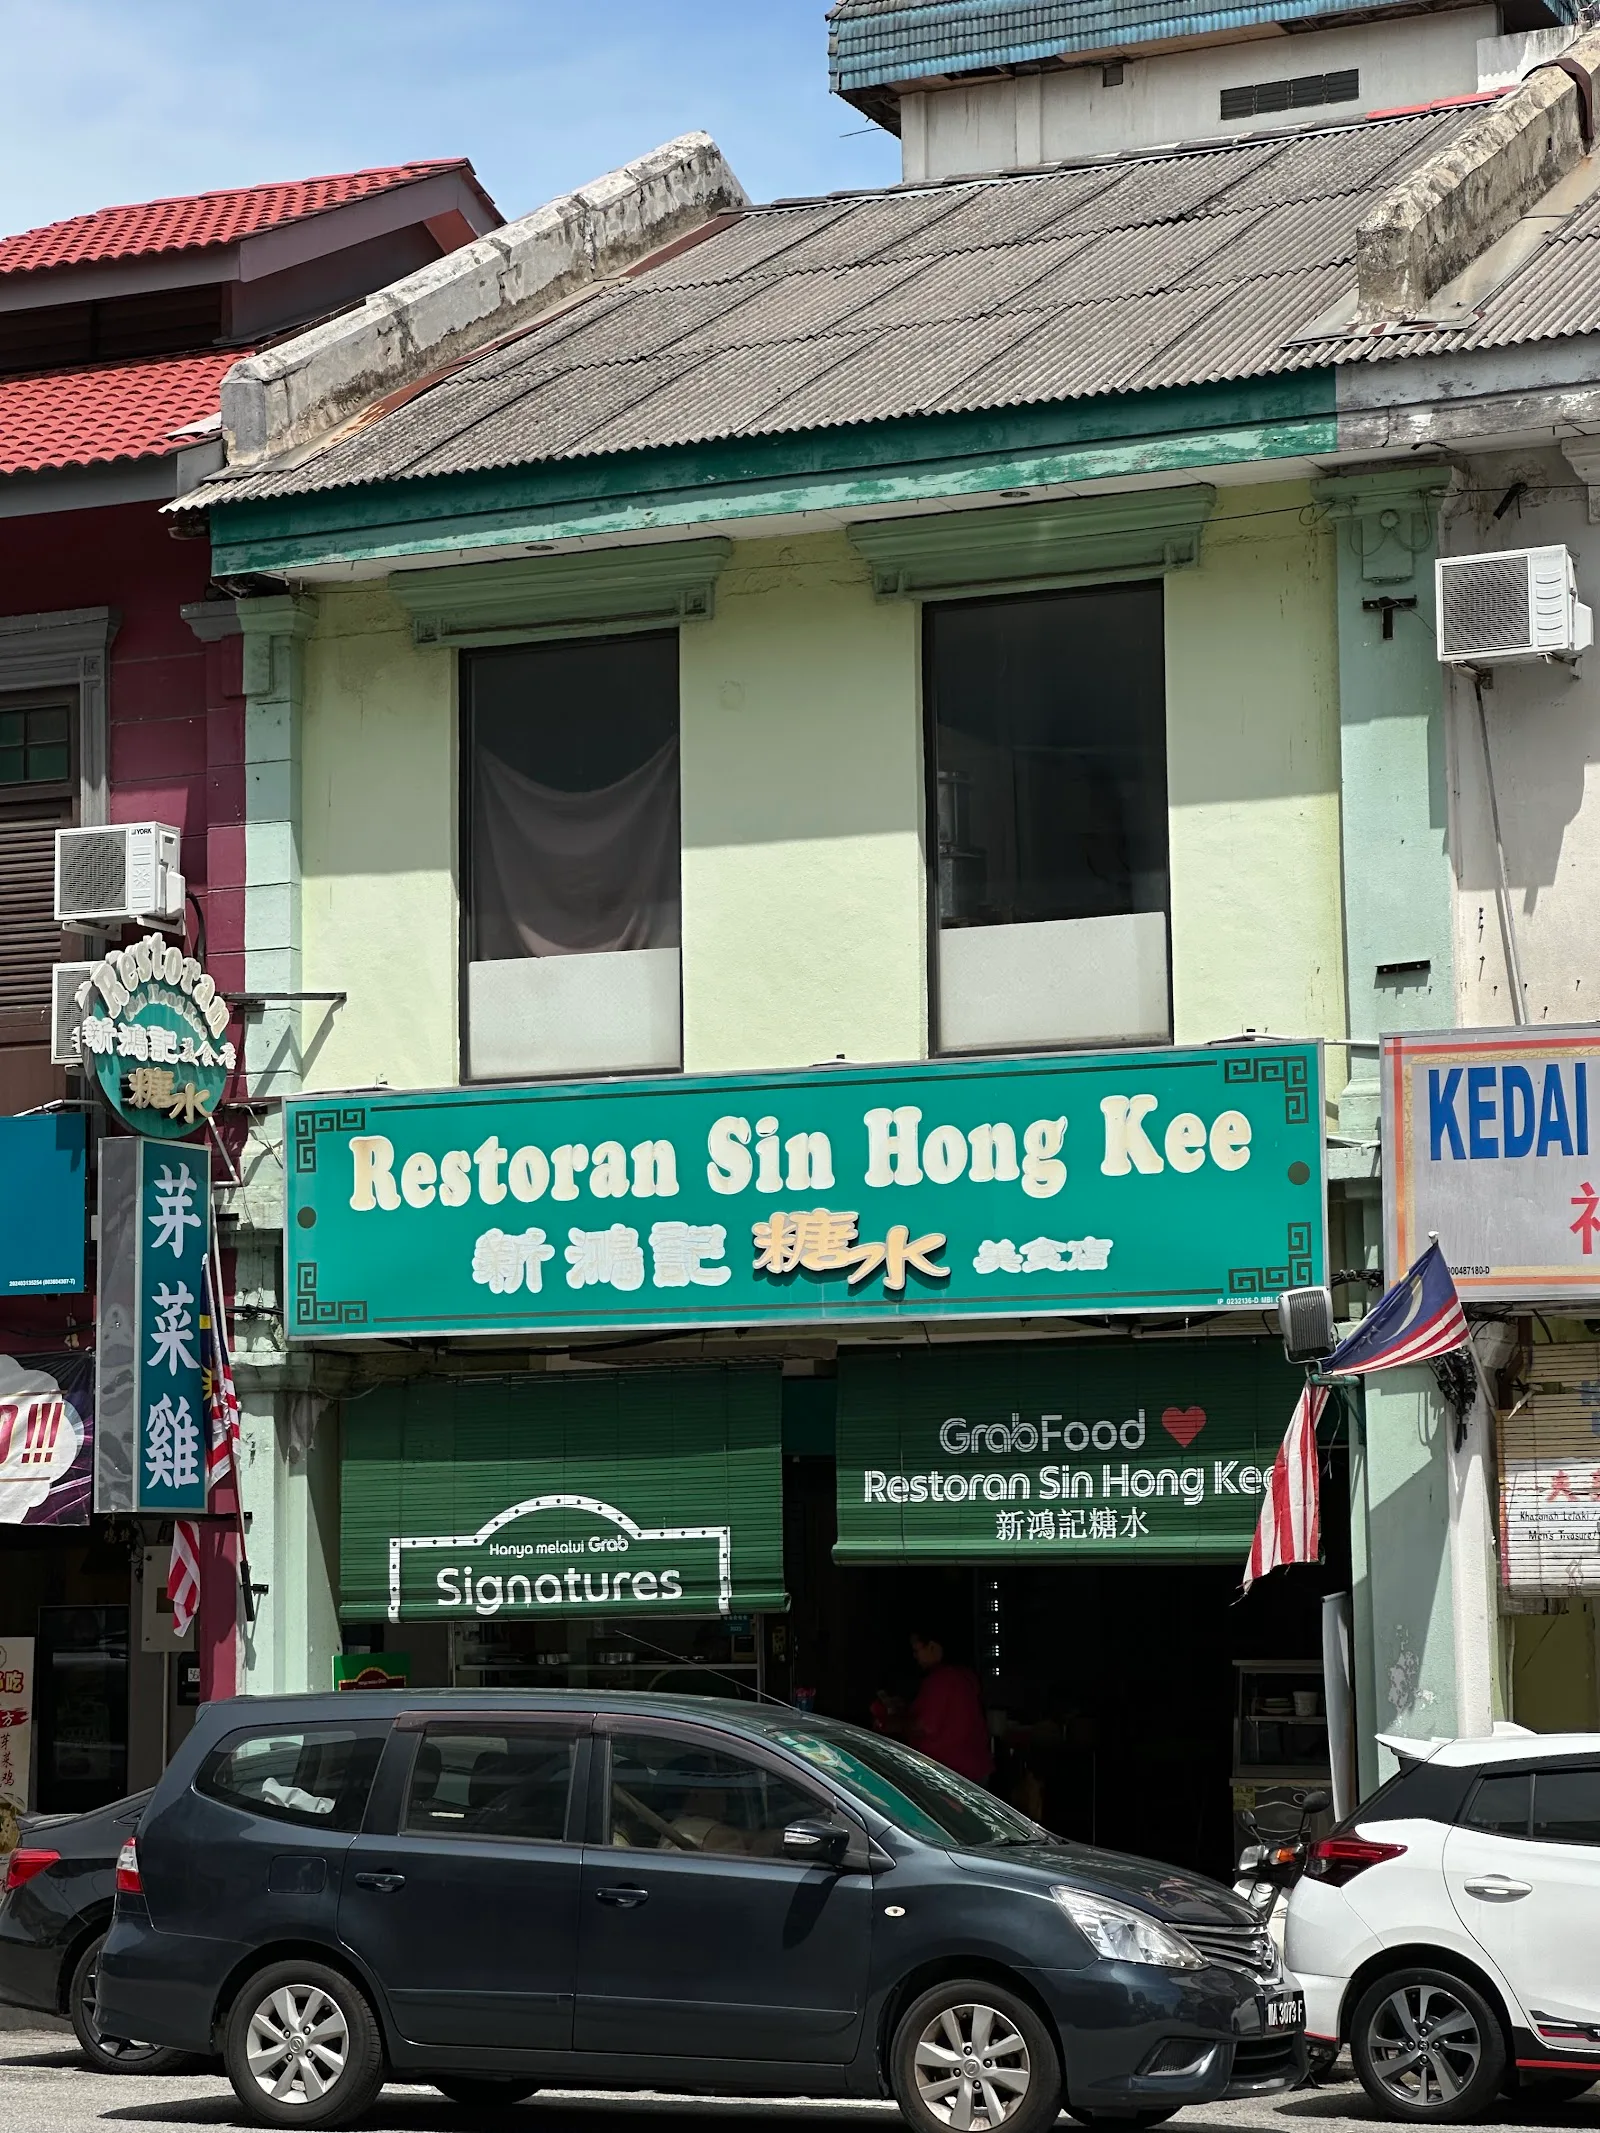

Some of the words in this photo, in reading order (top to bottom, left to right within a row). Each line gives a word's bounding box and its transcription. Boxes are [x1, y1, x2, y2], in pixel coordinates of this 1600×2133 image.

[91, 932, 230, 1040] Restoran
[127, 1066, 213, 1125] 糖水
[1428, 1062, 1589, 1161] KEDAI
[349, 1134, 680, 1211] Restoran
[707, 1115, 836, 1195] Sin
[864, 1105, 1068, 1198] Hong
[1099, 1094, 1252, 1177] Kee
[471, 1221, 732, 1295] 新鴻記
[752, 1207, 952, 1291] 糖水
[145, 1162, 202, 1490] 芽菜雞
[939, 1408, 1147, 1455] GrabFood
[863, 1469, 1030, 1503] Restoran
[1039, 1465, 1093, 1499] Sin
[1102, 1463, 1204, 1506] Hong
[489, 1543, 534, 1559] Hanya
[536, 1540, 585, 1555] melalui
[588, 1534, 629, 1553] Grab
[995, 1506, 1149, 1541] 新鴻記糖水
[436, 1566, 683, 1616] Signatures
[1279, 2001, 1297, 2025] 3073
[1297, 1999, 1303, 2022] F
